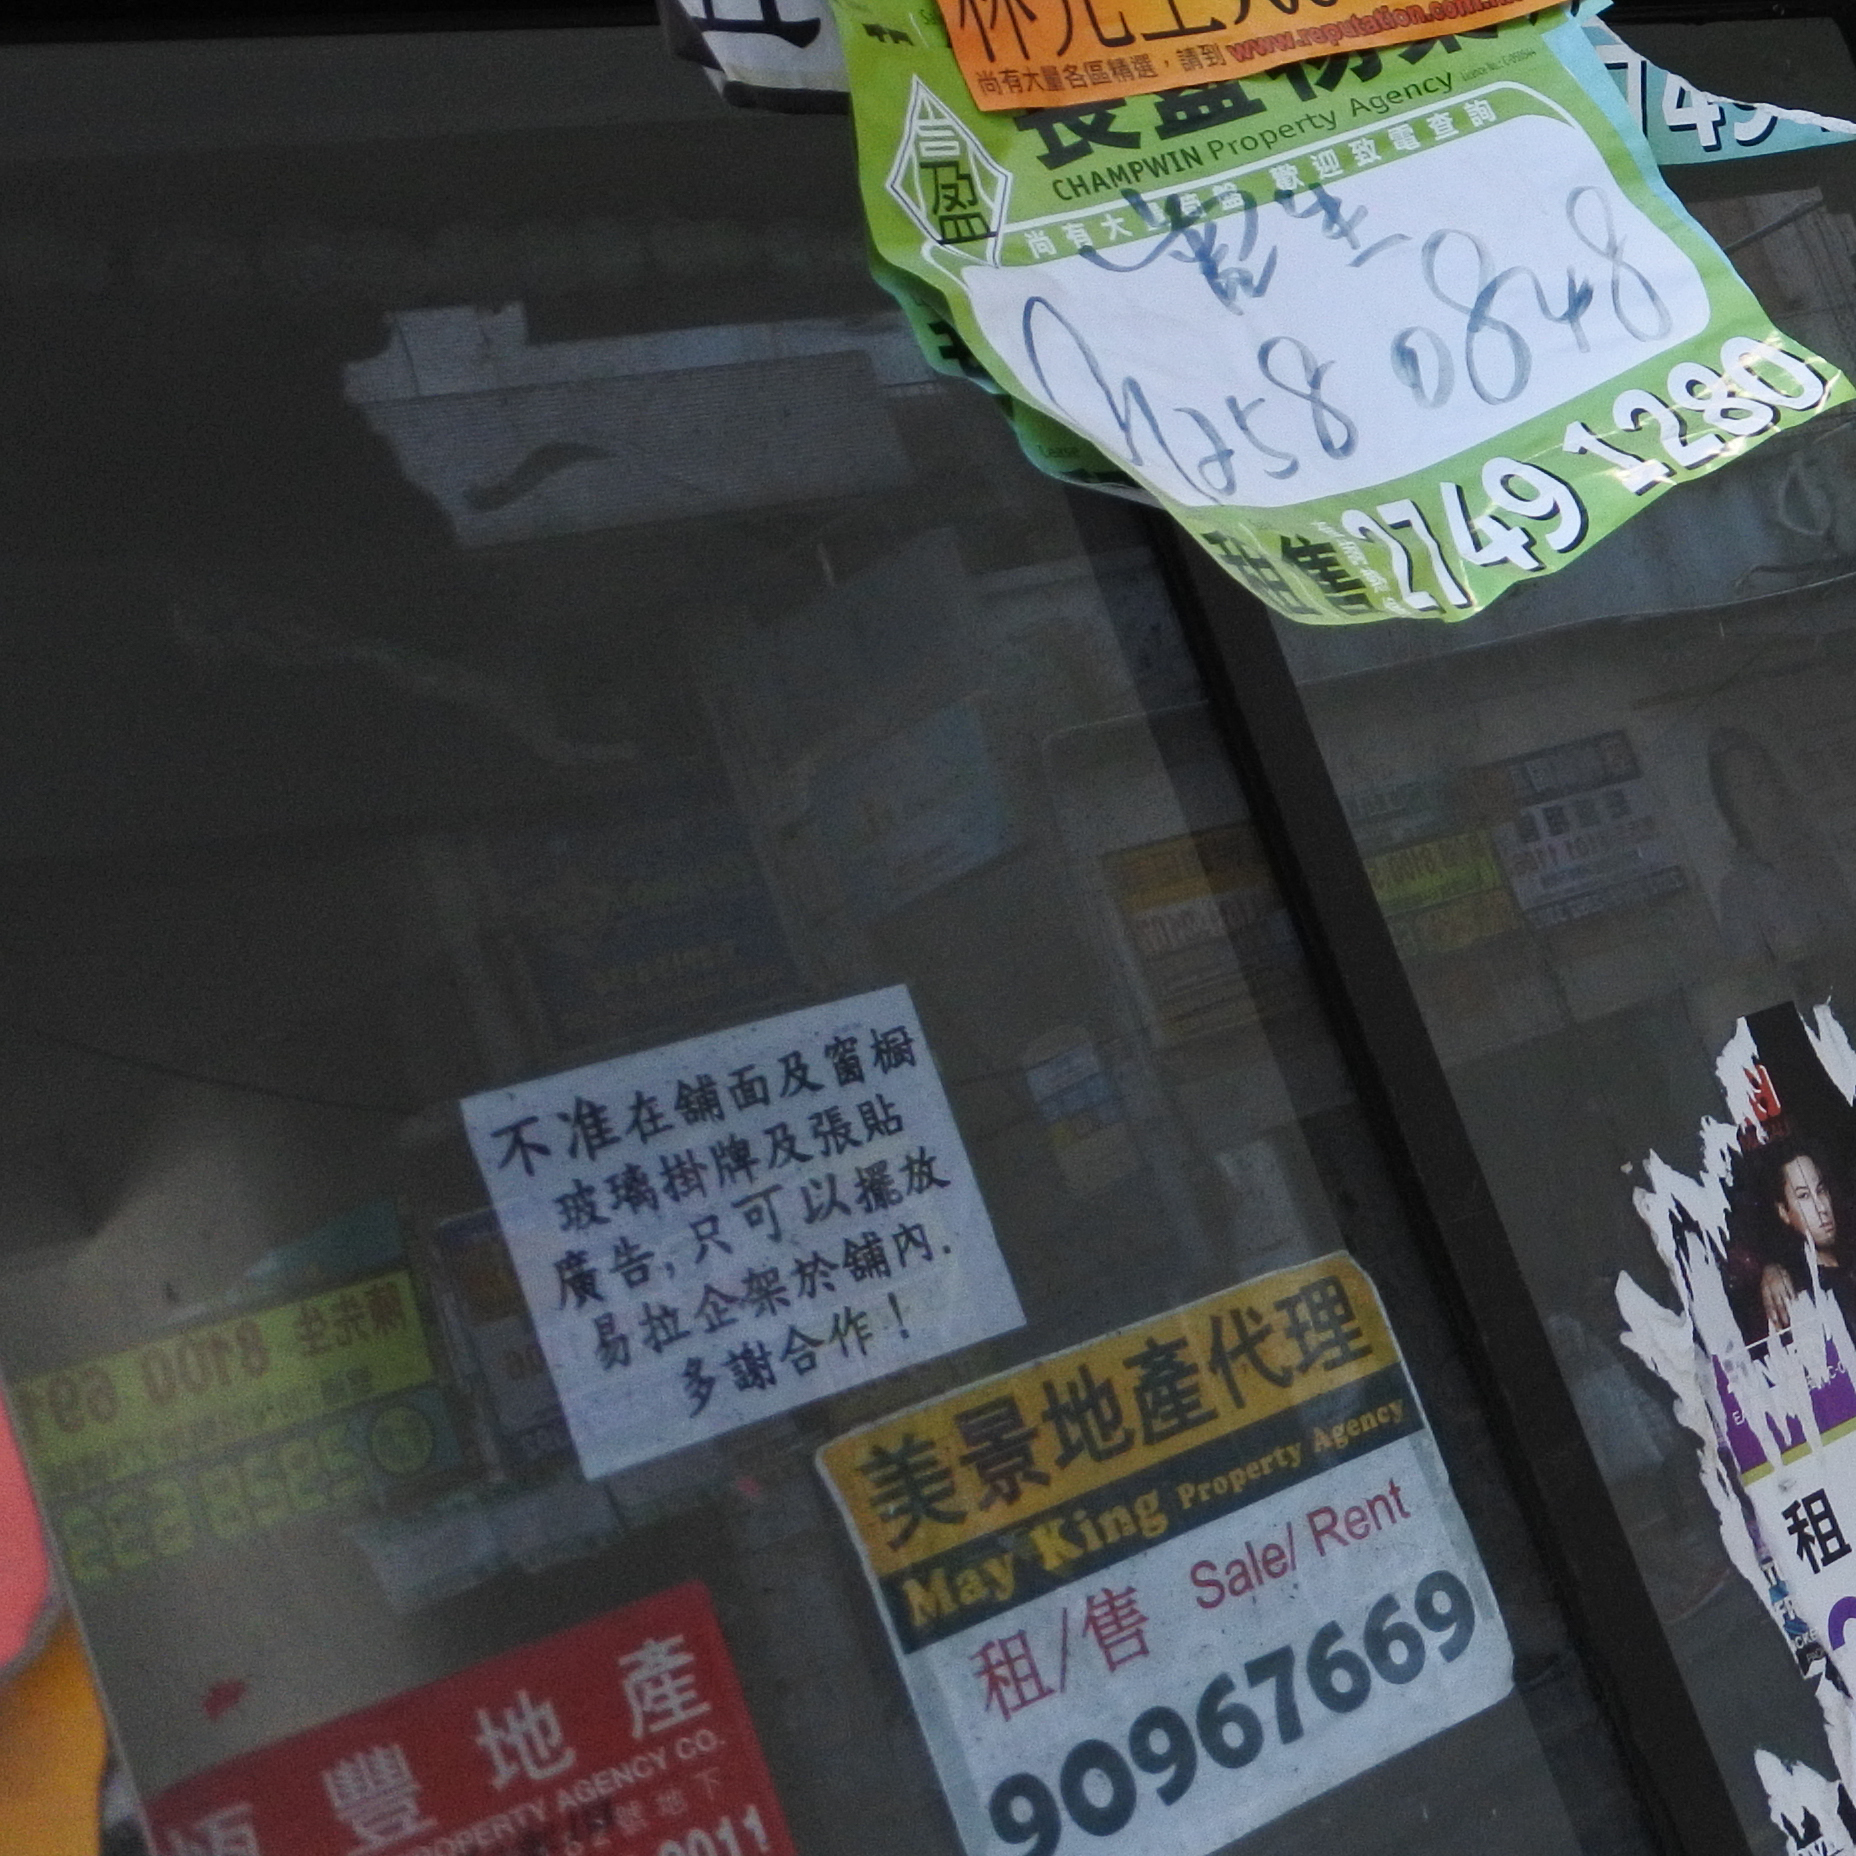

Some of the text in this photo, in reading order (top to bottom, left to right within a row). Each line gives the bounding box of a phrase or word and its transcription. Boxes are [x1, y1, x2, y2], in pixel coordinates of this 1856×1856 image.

[1050, 67, 1456, 204] CHAMPWIN Property Agency
[1341, 457, 1590, 615] 2749
[1562, 334, 1829, 498] 1280
[857, 1273, 1374, 1552] 美景地產代理
[903, 1396, 1405, 1629] May King Property Agency
[1782, 1487, 1853, 1575] 租
[969, 1478, 1412, 1723] 租/售 Sale/ Rent
[987, 1569, 1477, 1856] 90967669
[553, 1724, 727, 1810] AGENCY CO.
